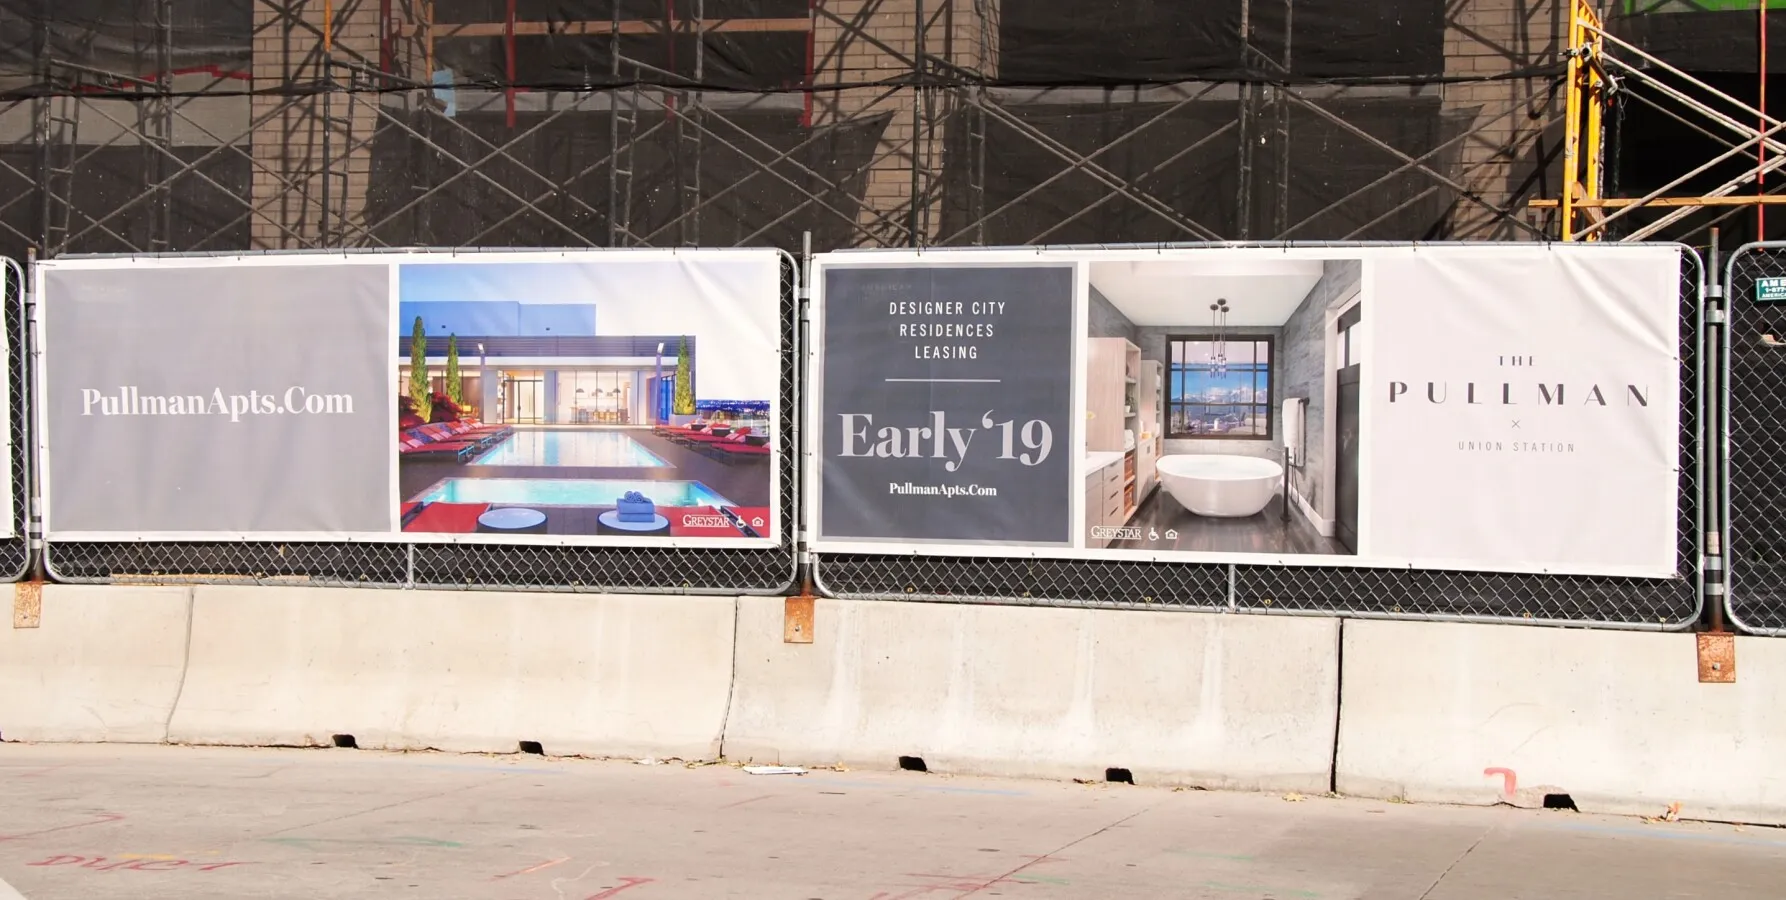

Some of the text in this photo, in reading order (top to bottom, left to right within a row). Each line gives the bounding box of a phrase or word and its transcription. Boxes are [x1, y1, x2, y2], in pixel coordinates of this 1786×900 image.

[889, 301, 1006, 315] DESIGNER CITY
[899, 323, 994, 337] RESIDENCES
[915, 345, 978, 359] LEASING
[1499, 355, 1536, 366] THE
[1389, 381, 1649, 407] PULLMAN
[80, 385, 354, 423] PullmanApts.Com
[837, 410, 978, 472] Early
[1458, 441, 1575, 453] UNION STATION
[889, 482, 997, 498] PullmanApts.Com
[683, 514, 730, 527] GREYSTAR
[1091, 525, 1142, 539] GREYSTAR
